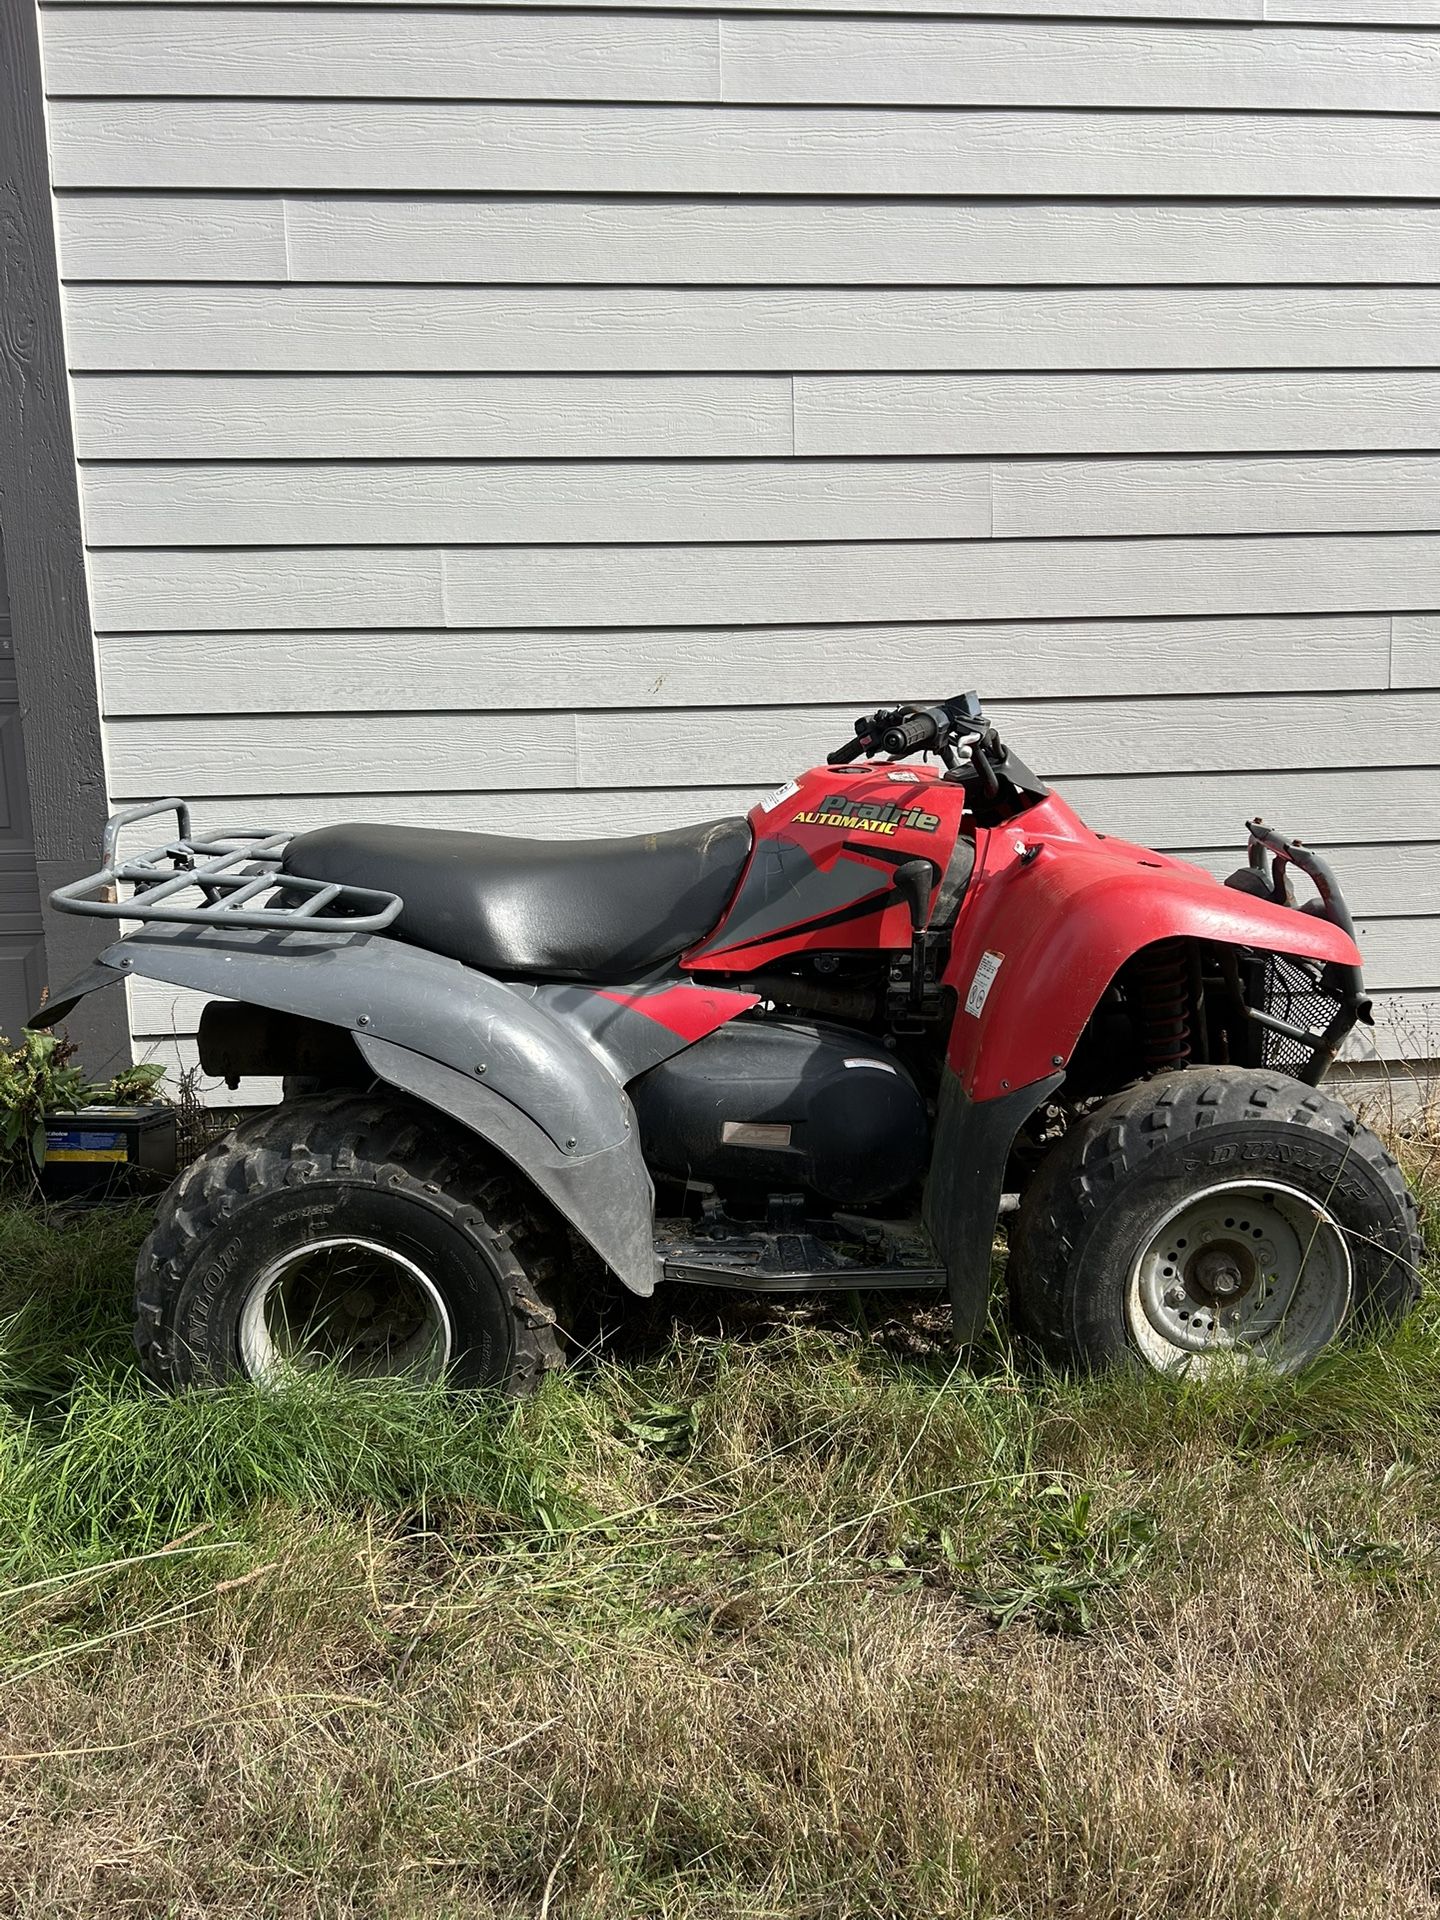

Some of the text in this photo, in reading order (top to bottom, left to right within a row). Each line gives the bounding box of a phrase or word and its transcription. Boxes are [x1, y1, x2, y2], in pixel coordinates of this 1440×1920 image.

[791, 811, 899, 836] AUTOMATIC
[819, 795, 940, 832] Prairie
[1207, 1141, 1369, 1201] DUNLOP
[187, 1236, 243, 1392] UNLOP
